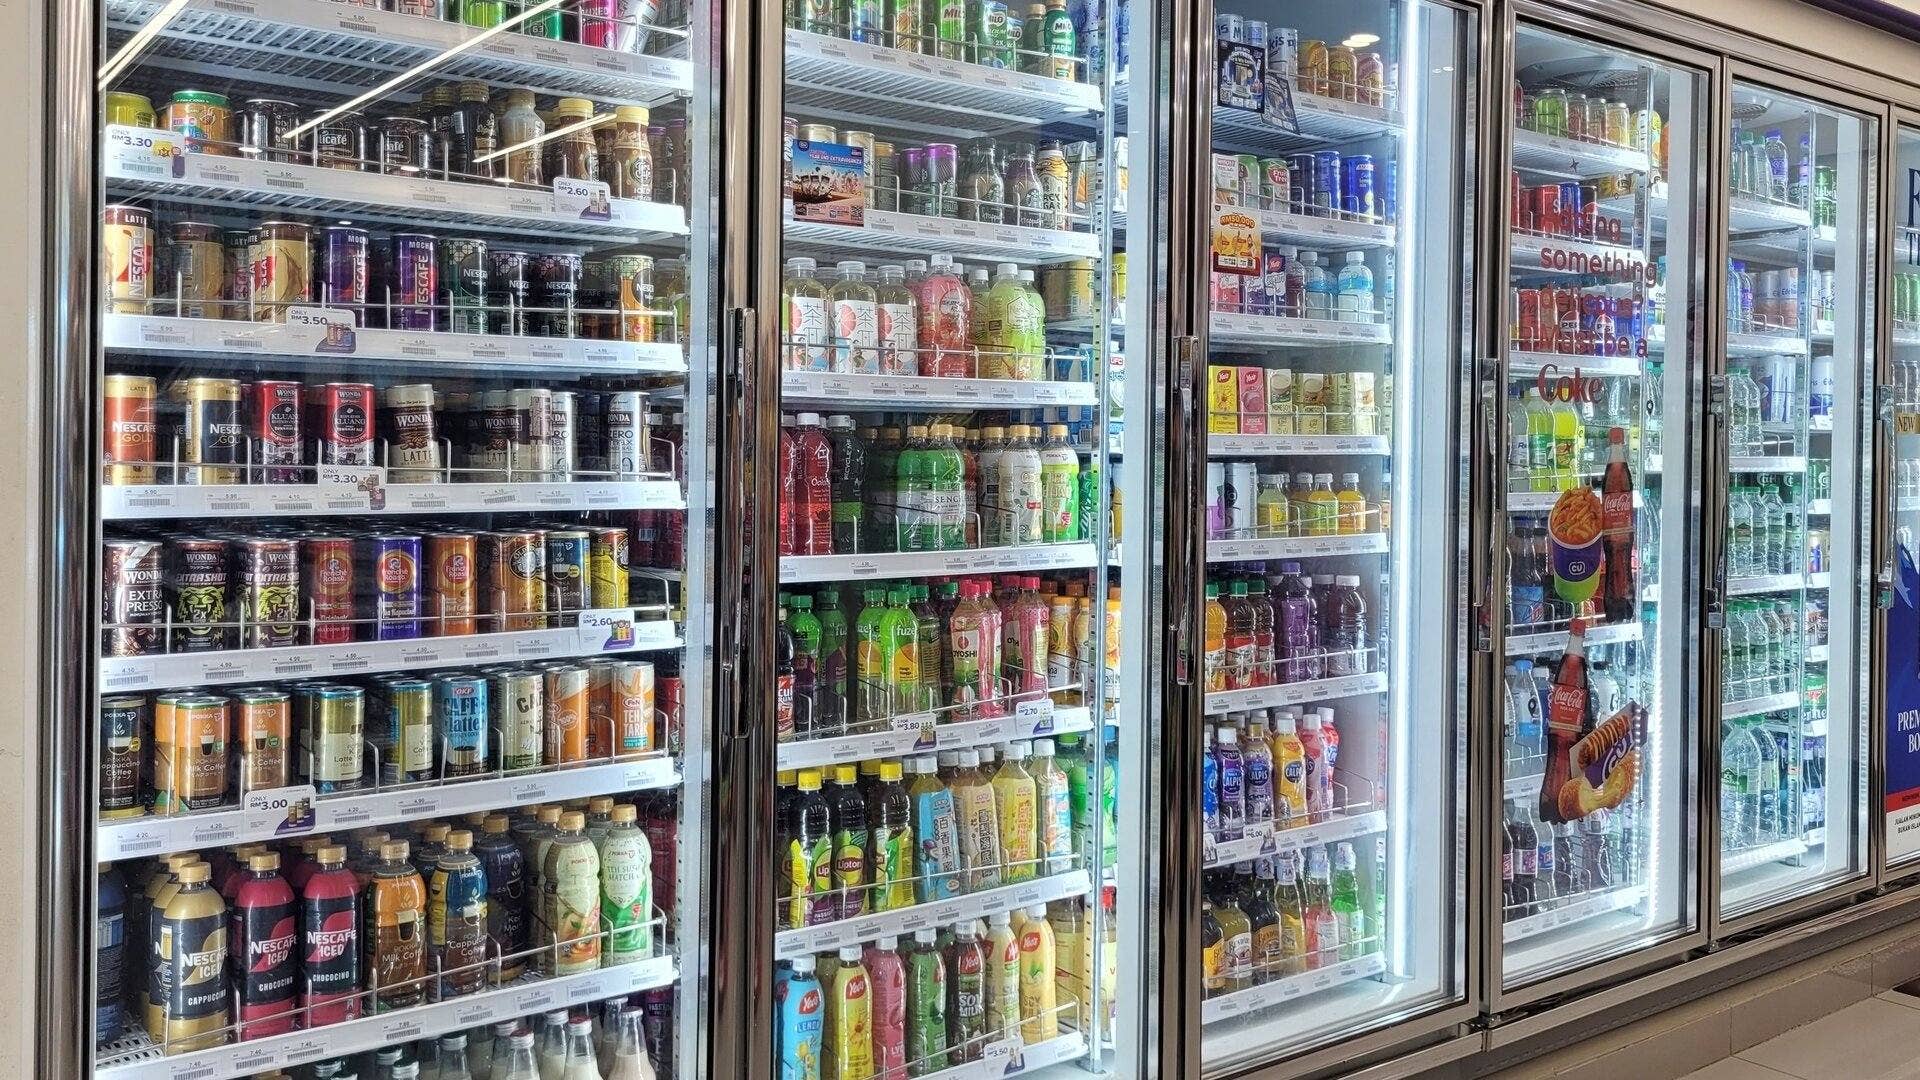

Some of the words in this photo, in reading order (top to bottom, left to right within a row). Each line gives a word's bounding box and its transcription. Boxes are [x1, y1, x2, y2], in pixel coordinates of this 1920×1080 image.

[1540, 246, 1658, 289] something
[1537, 363, 1605, 403] Coke
[396, 413, 432, 427] WONDA
[1897, 416, 1916, 432] NEW
[186, 552, 218, 563] WONDA
[1571, 562, 1584, 574] CU
[623, 709, 644, 723] TEH
[837, 856, 863, 869] Lipton
[306, 928, 359, 945] NESCAFE
[250, 934, 299, 955] NESCAFE
[318, 943, 346, 958] ICED
[267, 950, 289, 965] ICED
